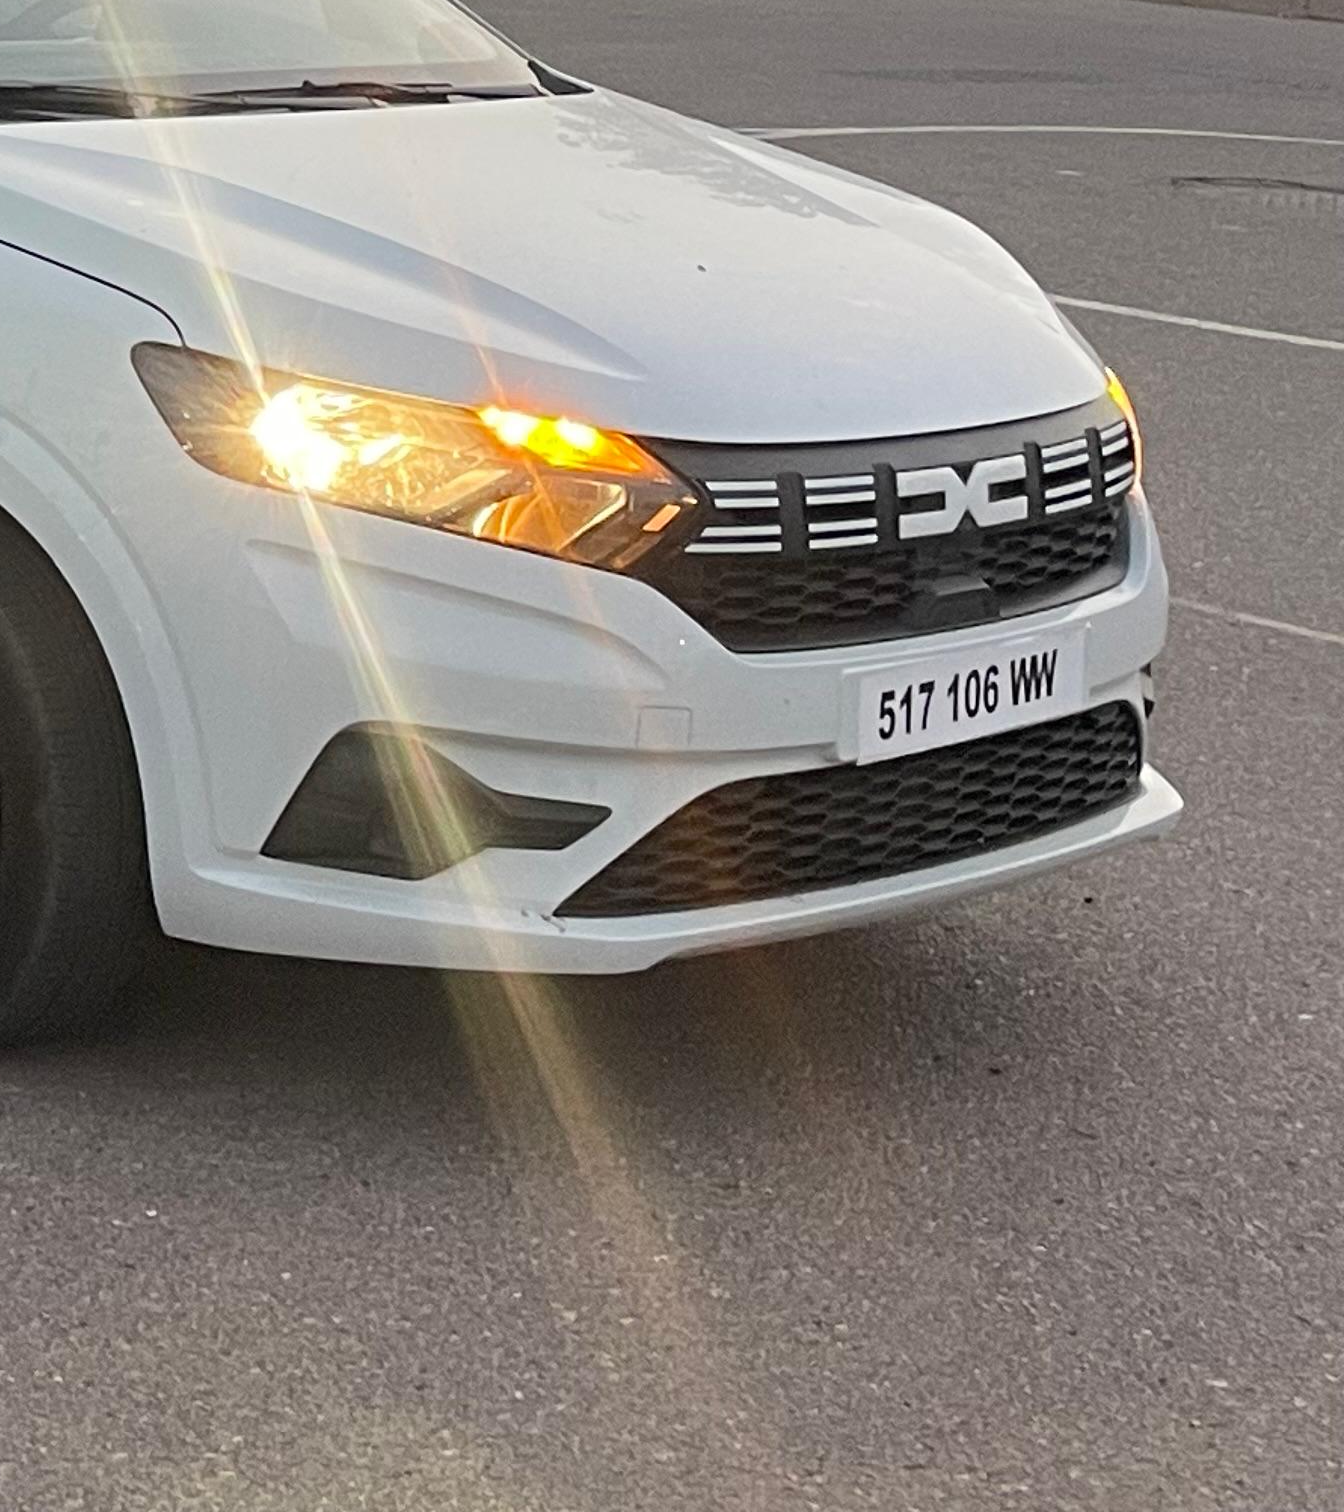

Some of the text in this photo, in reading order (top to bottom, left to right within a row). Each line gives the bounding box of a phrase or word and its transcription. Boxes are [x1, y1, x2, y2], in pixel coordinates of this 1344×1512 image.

[878, 648, 1059, 741] 517 106 WW
